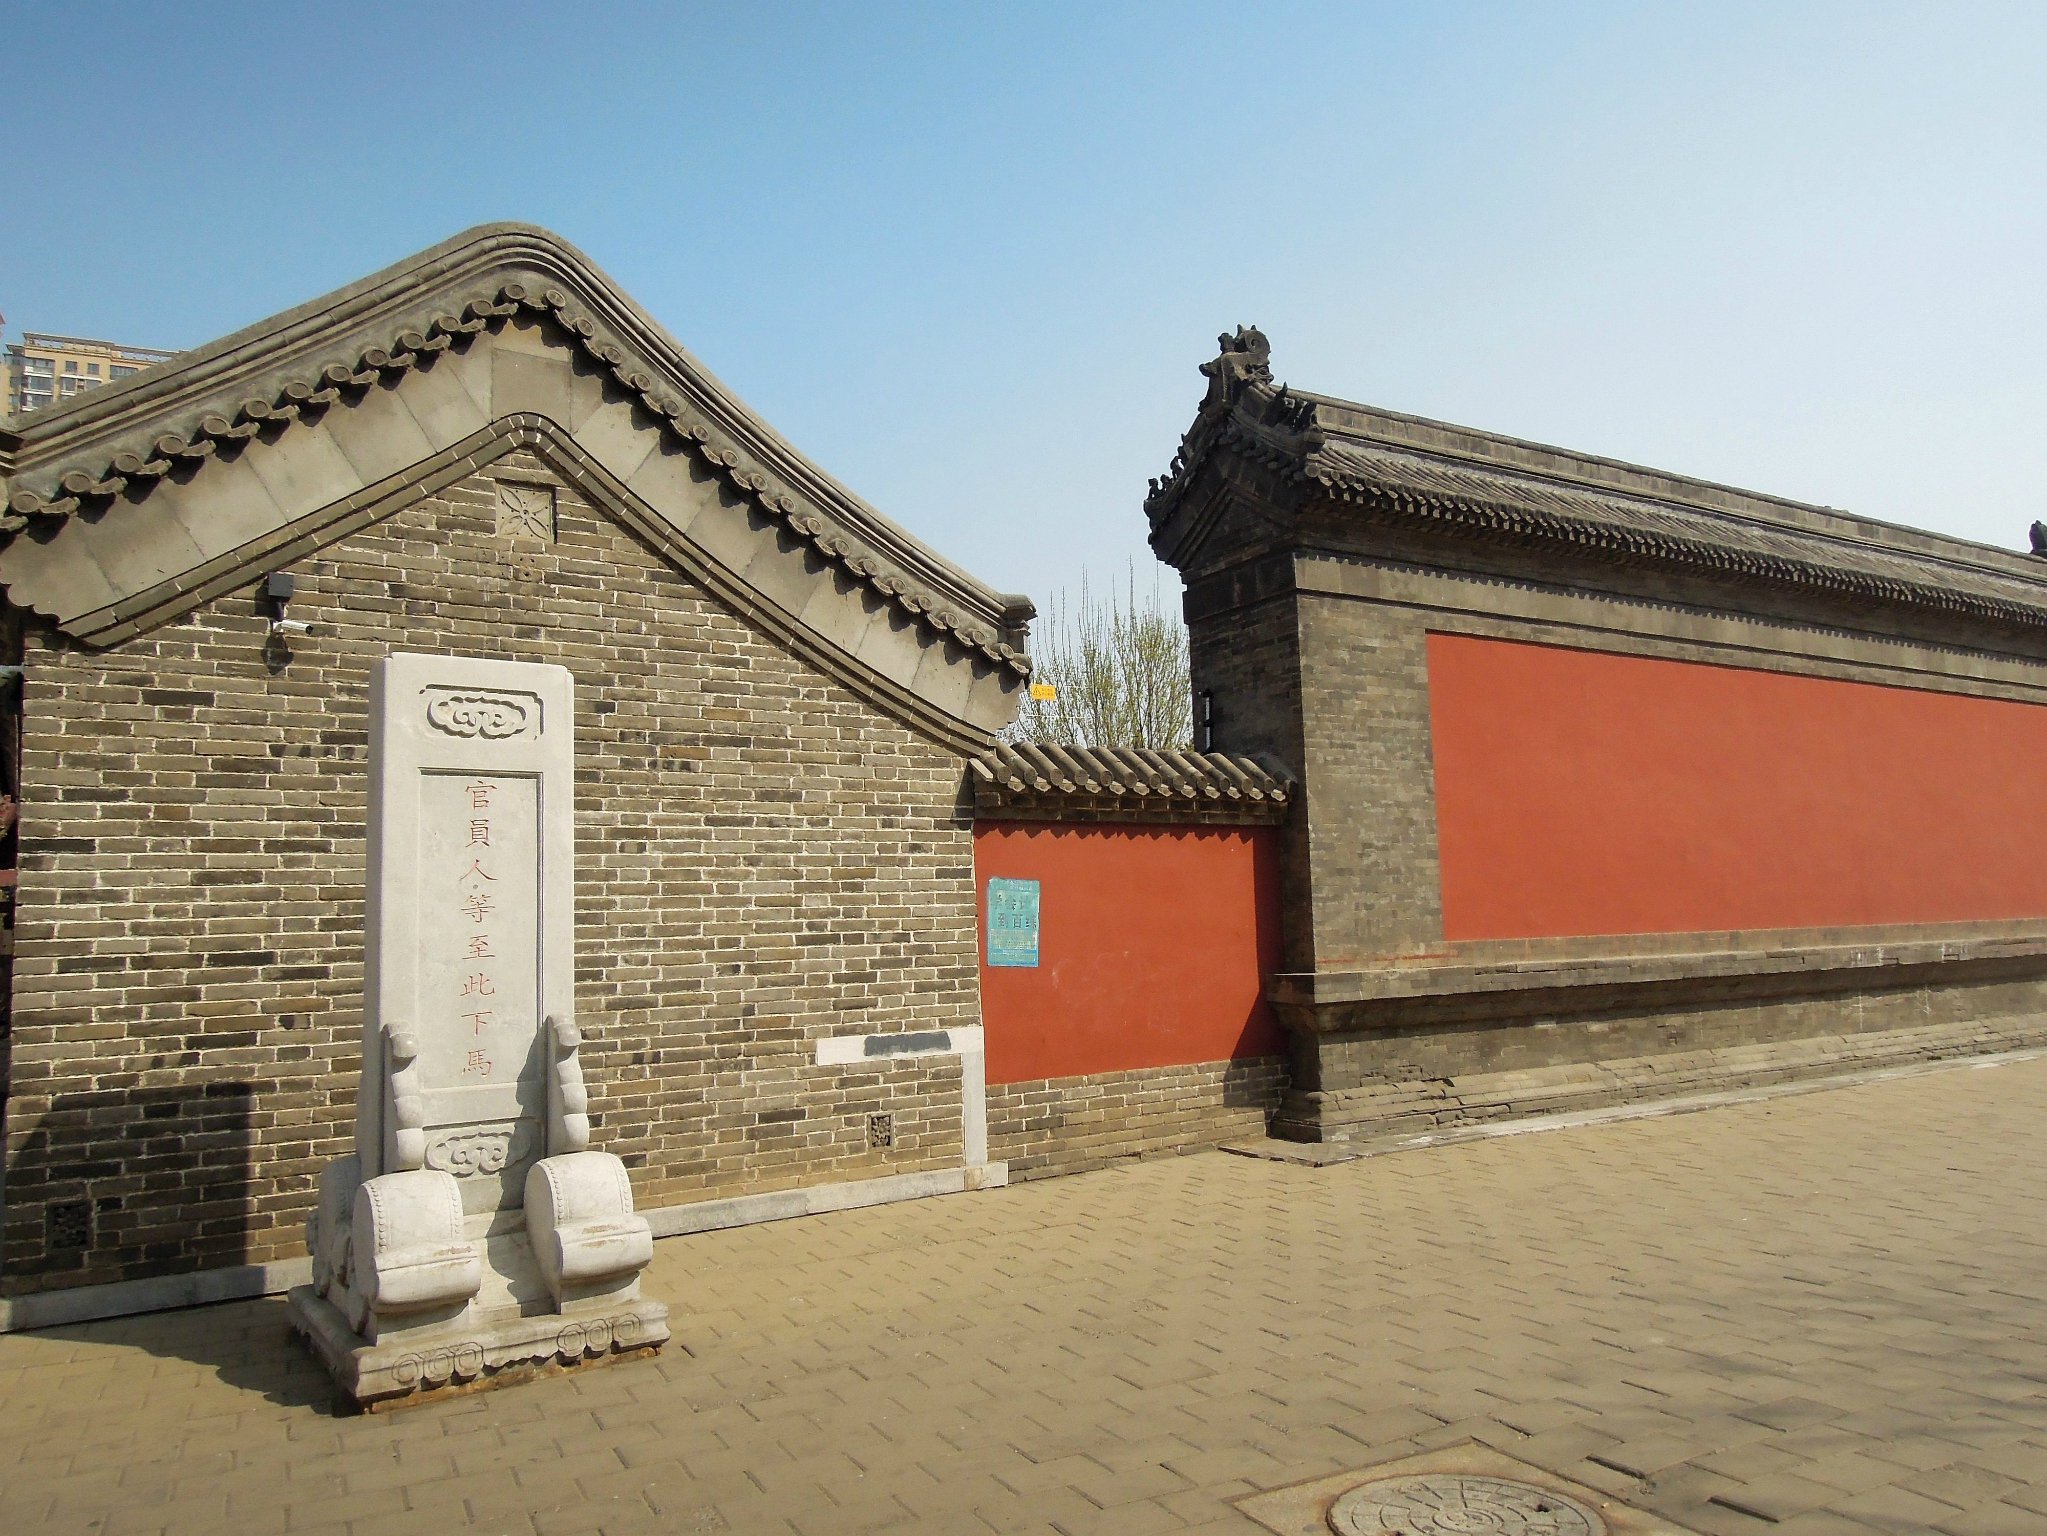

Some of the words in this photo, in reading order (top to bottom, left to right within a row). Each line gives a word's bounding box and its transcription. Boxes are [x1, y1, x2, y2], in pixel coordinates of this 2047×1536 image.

[459, 780, 499, 1077] 官員人等至此下馬
